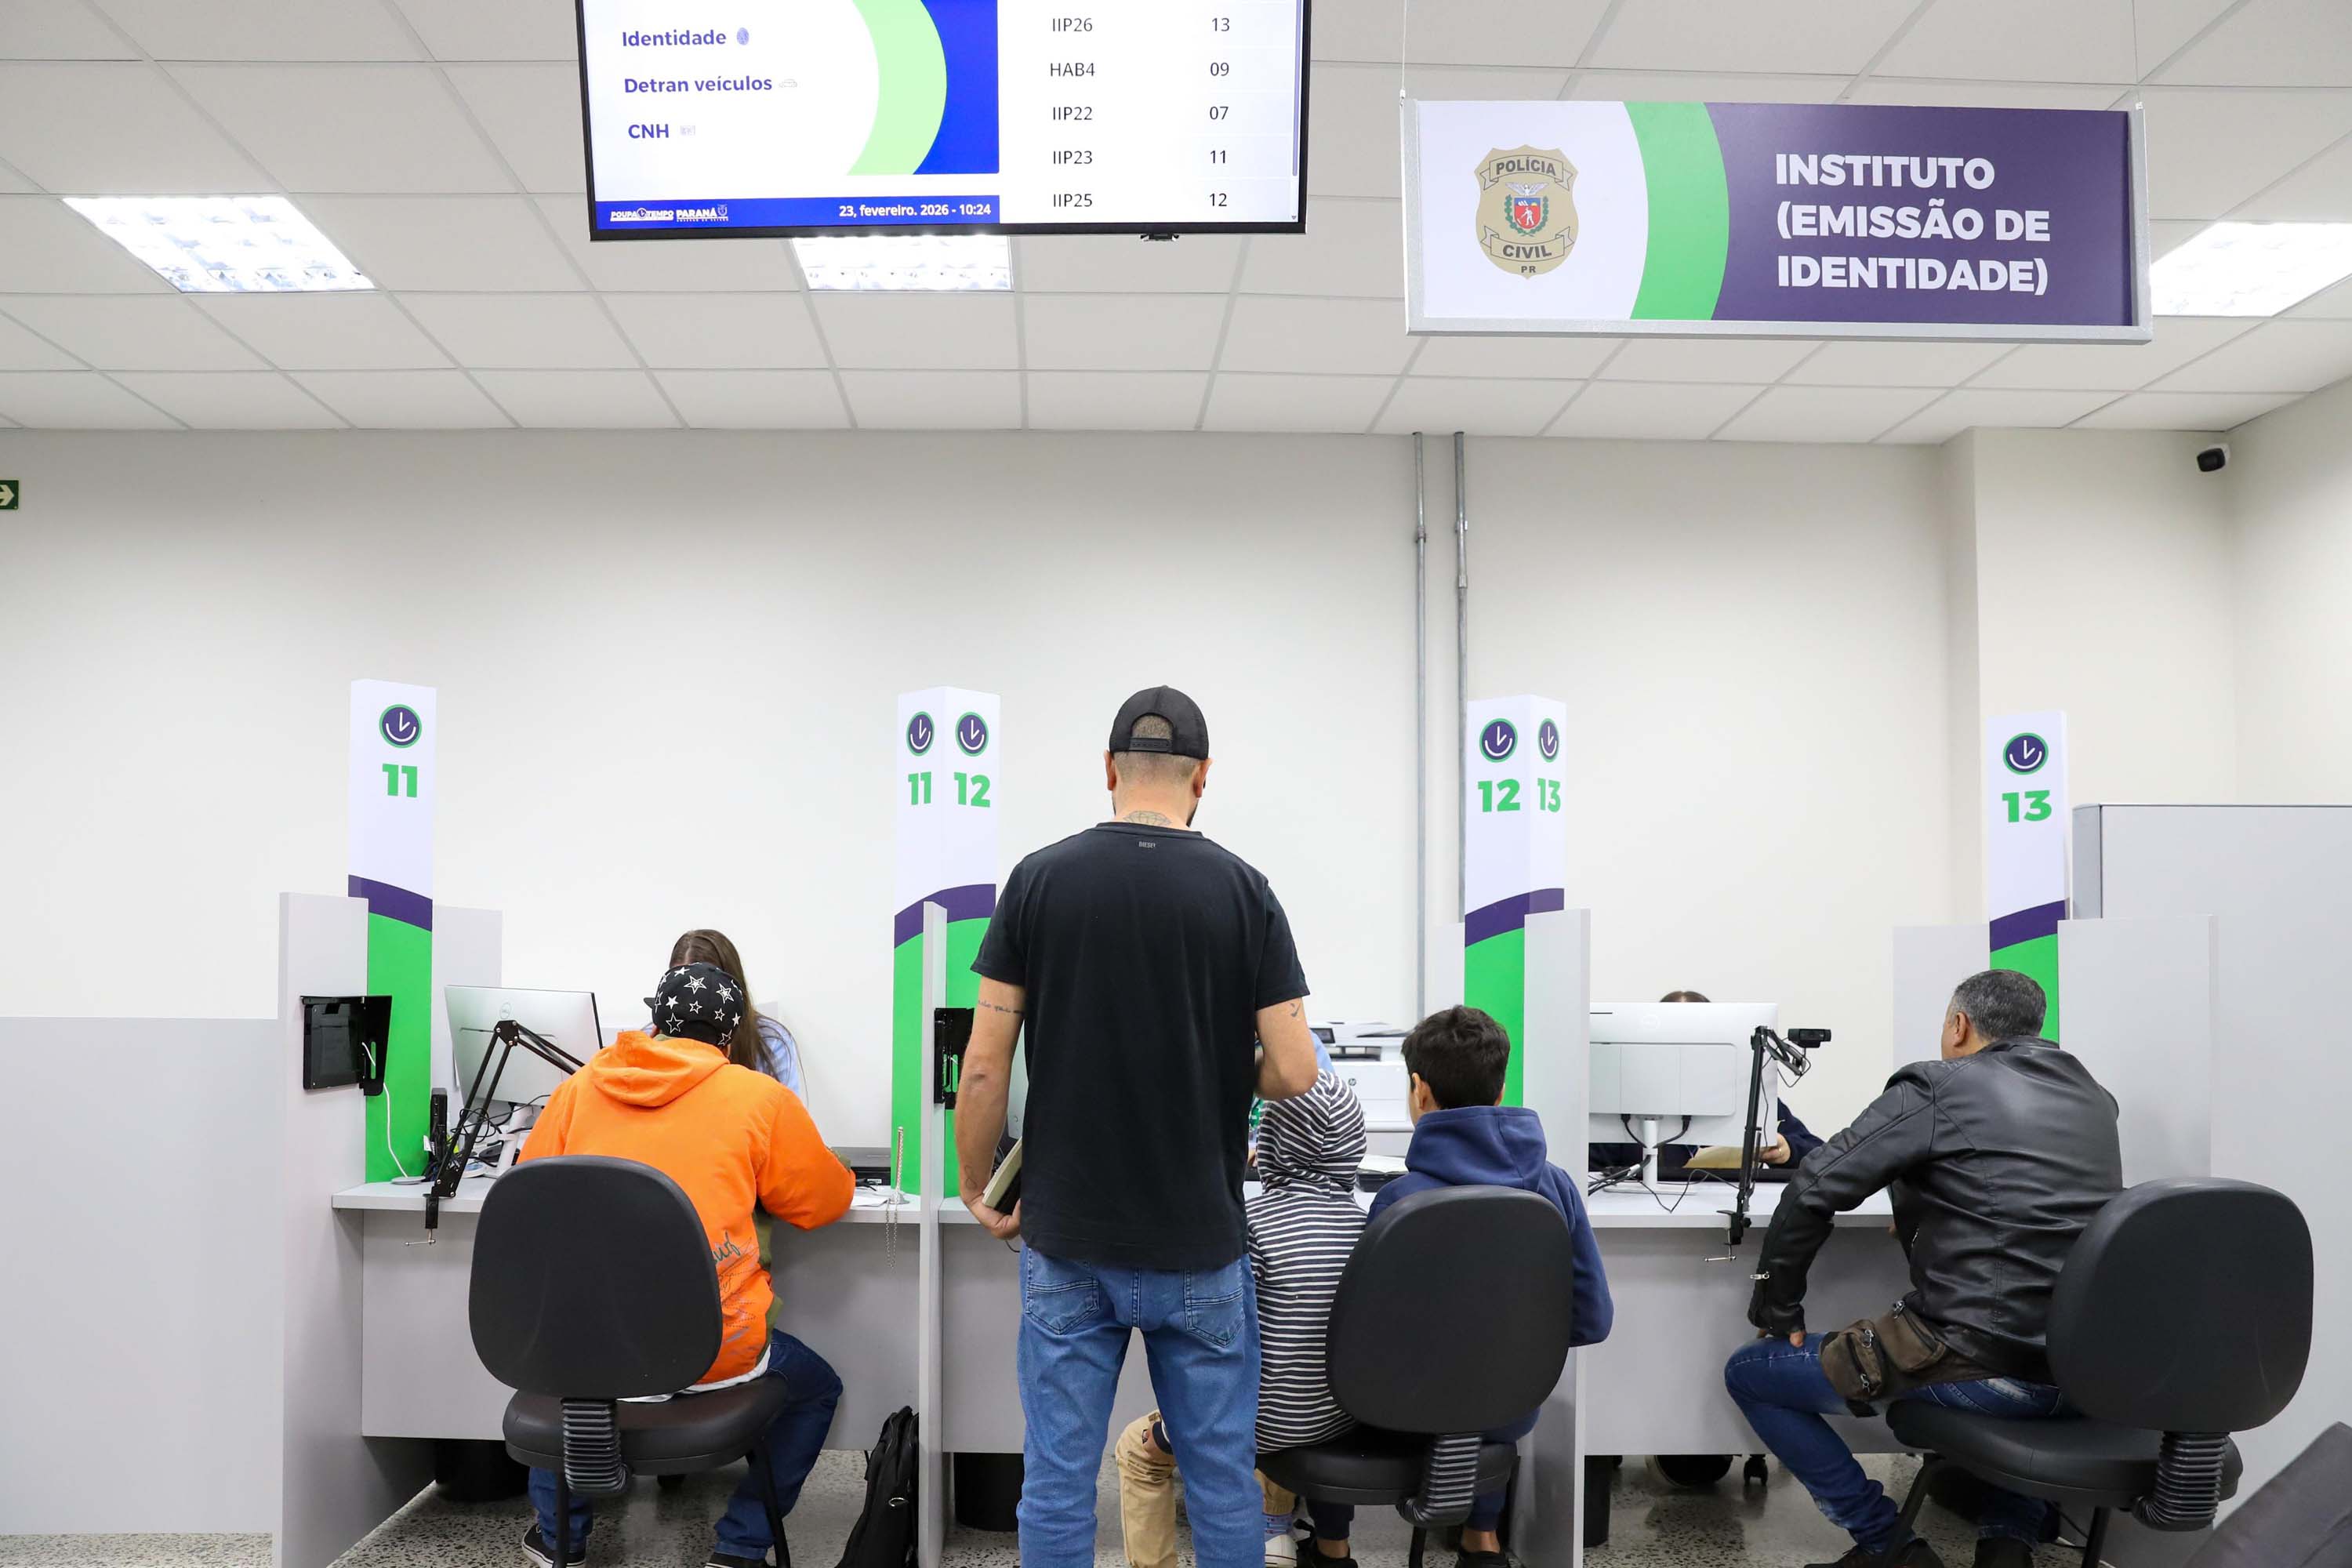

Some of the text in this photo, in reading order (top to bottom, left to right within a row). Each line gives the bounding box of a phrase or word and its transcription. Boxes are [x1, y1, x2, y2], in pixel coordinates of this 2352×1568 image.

[1051, 17, 1093, 32] IIP26
[1211, 17, 1230, 32] 13
[622, 29, 727, 47] Identidade
[1050, 62, 1095, 77] HAB4
[1210, 62, 1229, 77] 09
[624, 76, 772, 93] Detran veículos
[1052, 106, 1093, 121] IIP22
[1209, 106, 1229, 120] 07
[628, 123, 670, 140] CNH
[1052, 150, 1093, 165] IIP23
[1210, 150, 1226, 164] 11
[1496, 157, 1556, 176] POLÍCIA
[1775, 153, 1995, 191] INSTITUTO
[1052, 193, 1093, 208] IIP25
[1209, 193, 1227, 207] 12
[839, 205, 857, 218] 23,
[859, 205, 917, 216] fevereiro.
[920, 205, 949, 216] 2026
[959, 204, 992, 215] 10:24
[1777, 199, 2051, 242] (EMISSÃO DE
[1503, 245, 1552, 258] CIVIL
[1777, 255, 2049, 296] IDENTIDADE)
[382, 763, 418, 798] 11
[908, 771, 932, 805] 11
[953, 771, 991, 808] 12
[1477, 779, 1521, 813] 12
[1537, 778, 1561, 813] 13
[2002, 789, 2053, 823] 13
